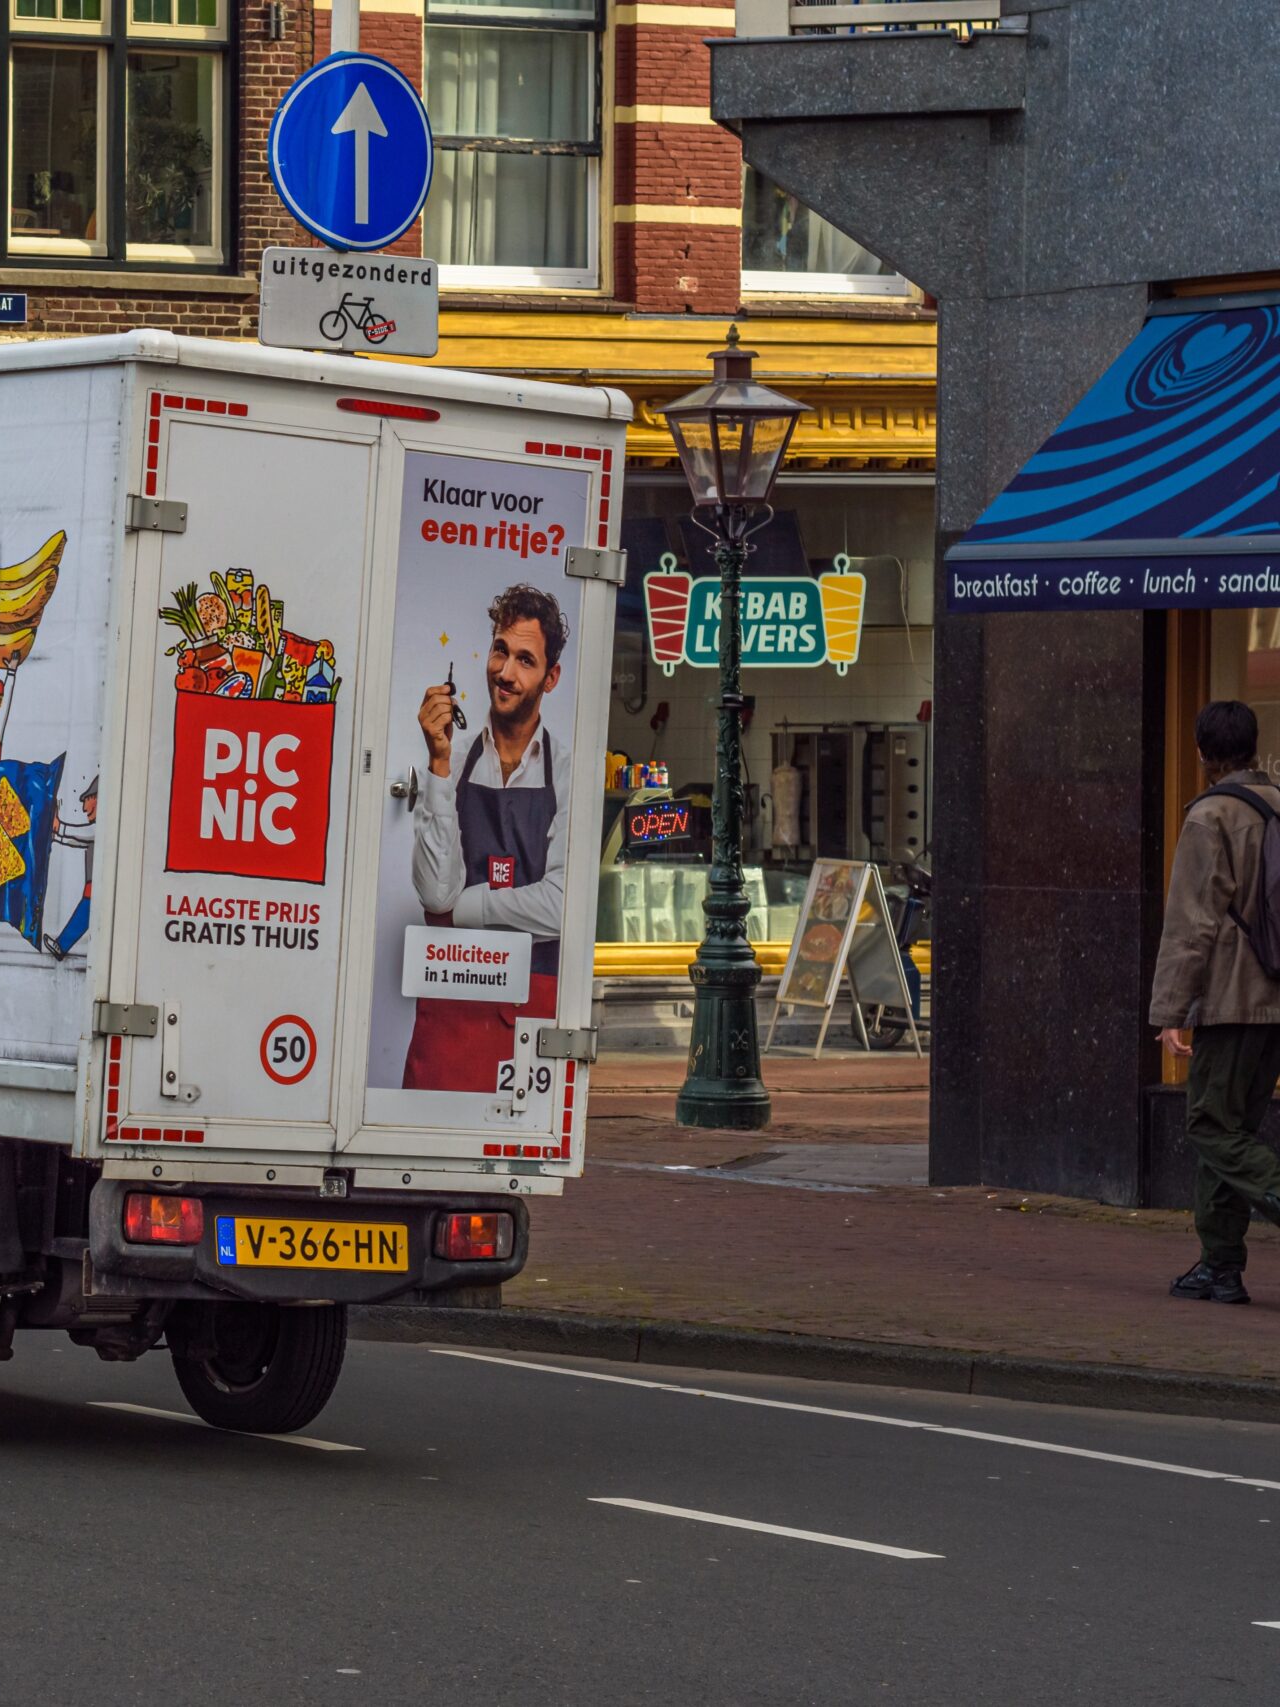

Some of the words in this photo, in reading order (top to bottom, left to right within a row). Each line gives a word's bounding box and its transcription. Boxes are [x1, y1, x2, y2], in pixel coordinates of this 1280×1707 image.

[272, 257, 432, 286] uitgezonderd
[423, 478, 487, 508] Klaar
[491, 492, 544, 515] voor
[421, 519, 478, 546] een
[484, 520, 565, 558] ritje?
[954, 573, 1039, 598] breakfast
[1058, 570, 1122, 596] coffee
[1143, 567, 1196, 594] lunch
[631, 812, 689, 837] OPEN
[166, 895, 261, 921] LAAGSTE
[265, 901, 320, 925] PRIJS
[164, 920, 246, 947] GRATIS
[252, 925, 320, 951] THUIS
[426, 944, 509, 965] Solliciteer
[425, 967, 438, 982] in
[441, 969, 449, 982] 1
[452, 970, 507, 986] minuut!
[272, 1036, 306, 1064] 50
[220, 1246, 235, 1257] NL
[245, 1225, 398, 1265] V-366-HN
